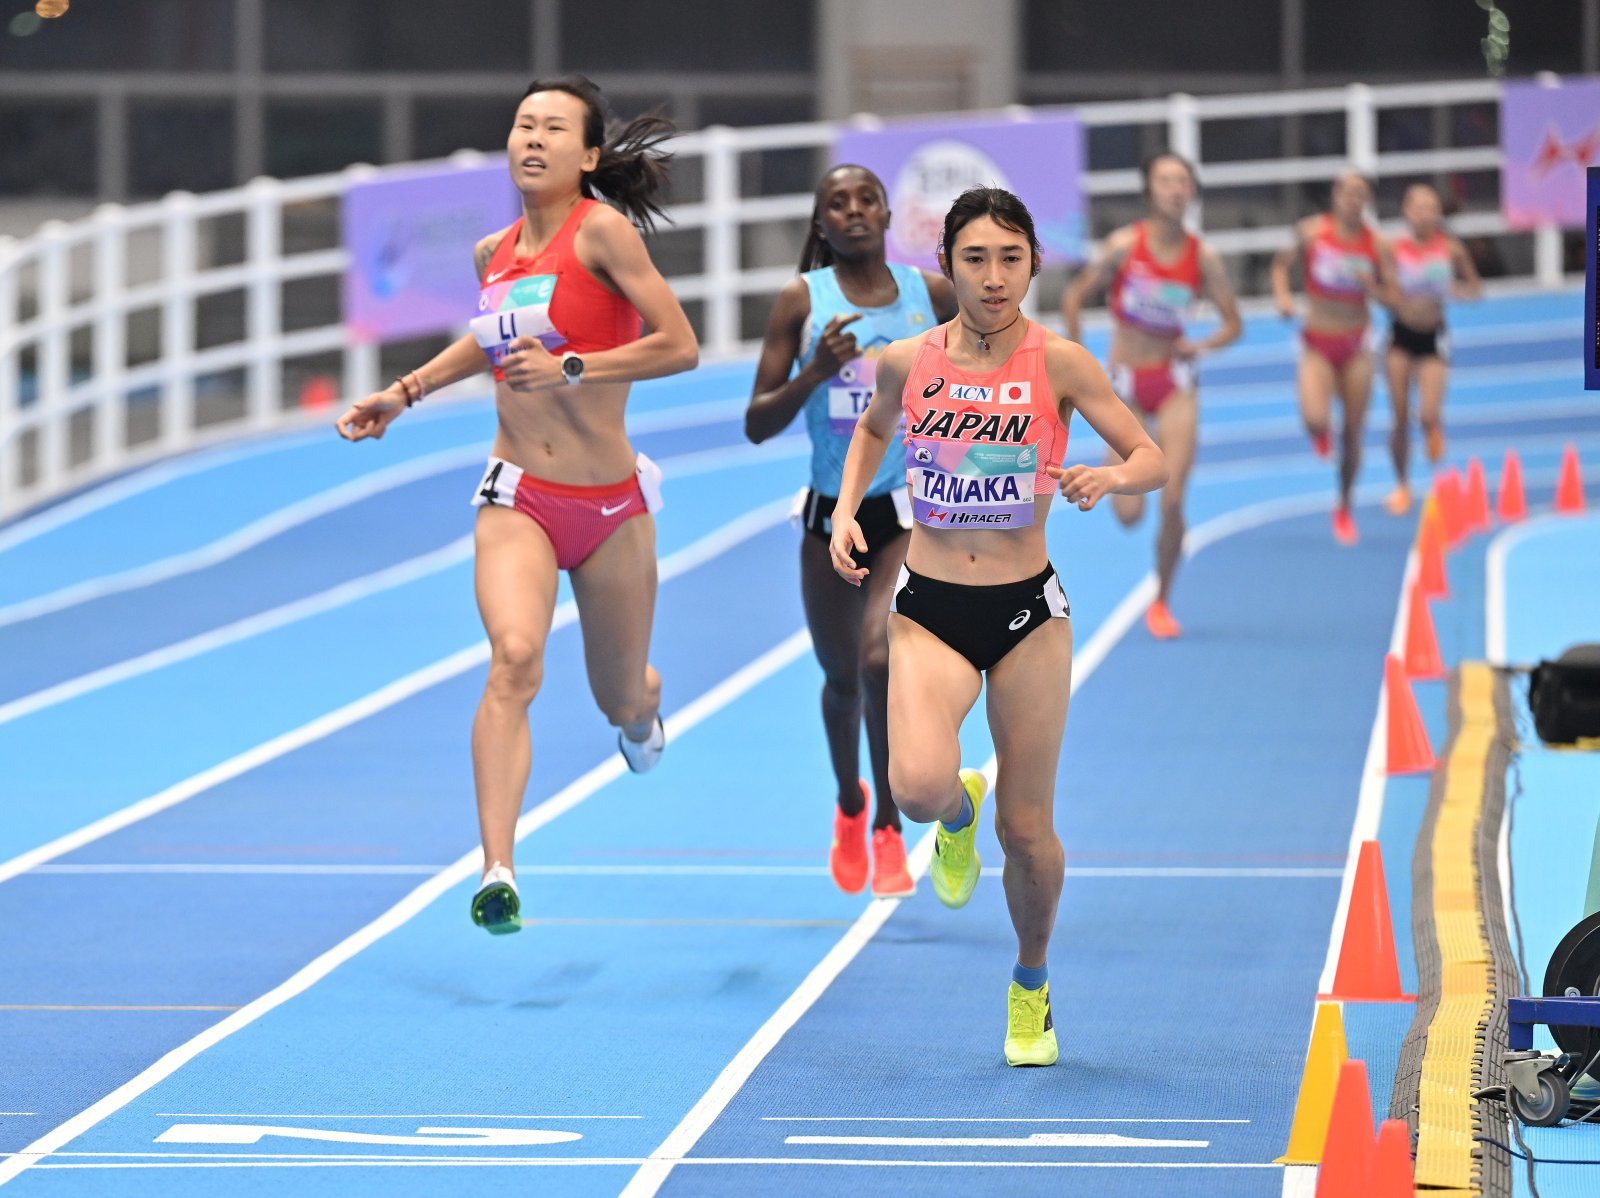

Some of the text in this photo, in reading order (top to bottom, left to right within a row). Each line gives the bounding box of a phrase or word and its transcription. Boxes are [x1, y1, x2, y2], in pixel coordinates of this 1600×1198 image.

[499, 313, 517, 340] LI
[950, 386, 991, 401] ACN
[911, 408, 1032, 443] JAPAN
[922, 470, 1020, 503] TANAKA
